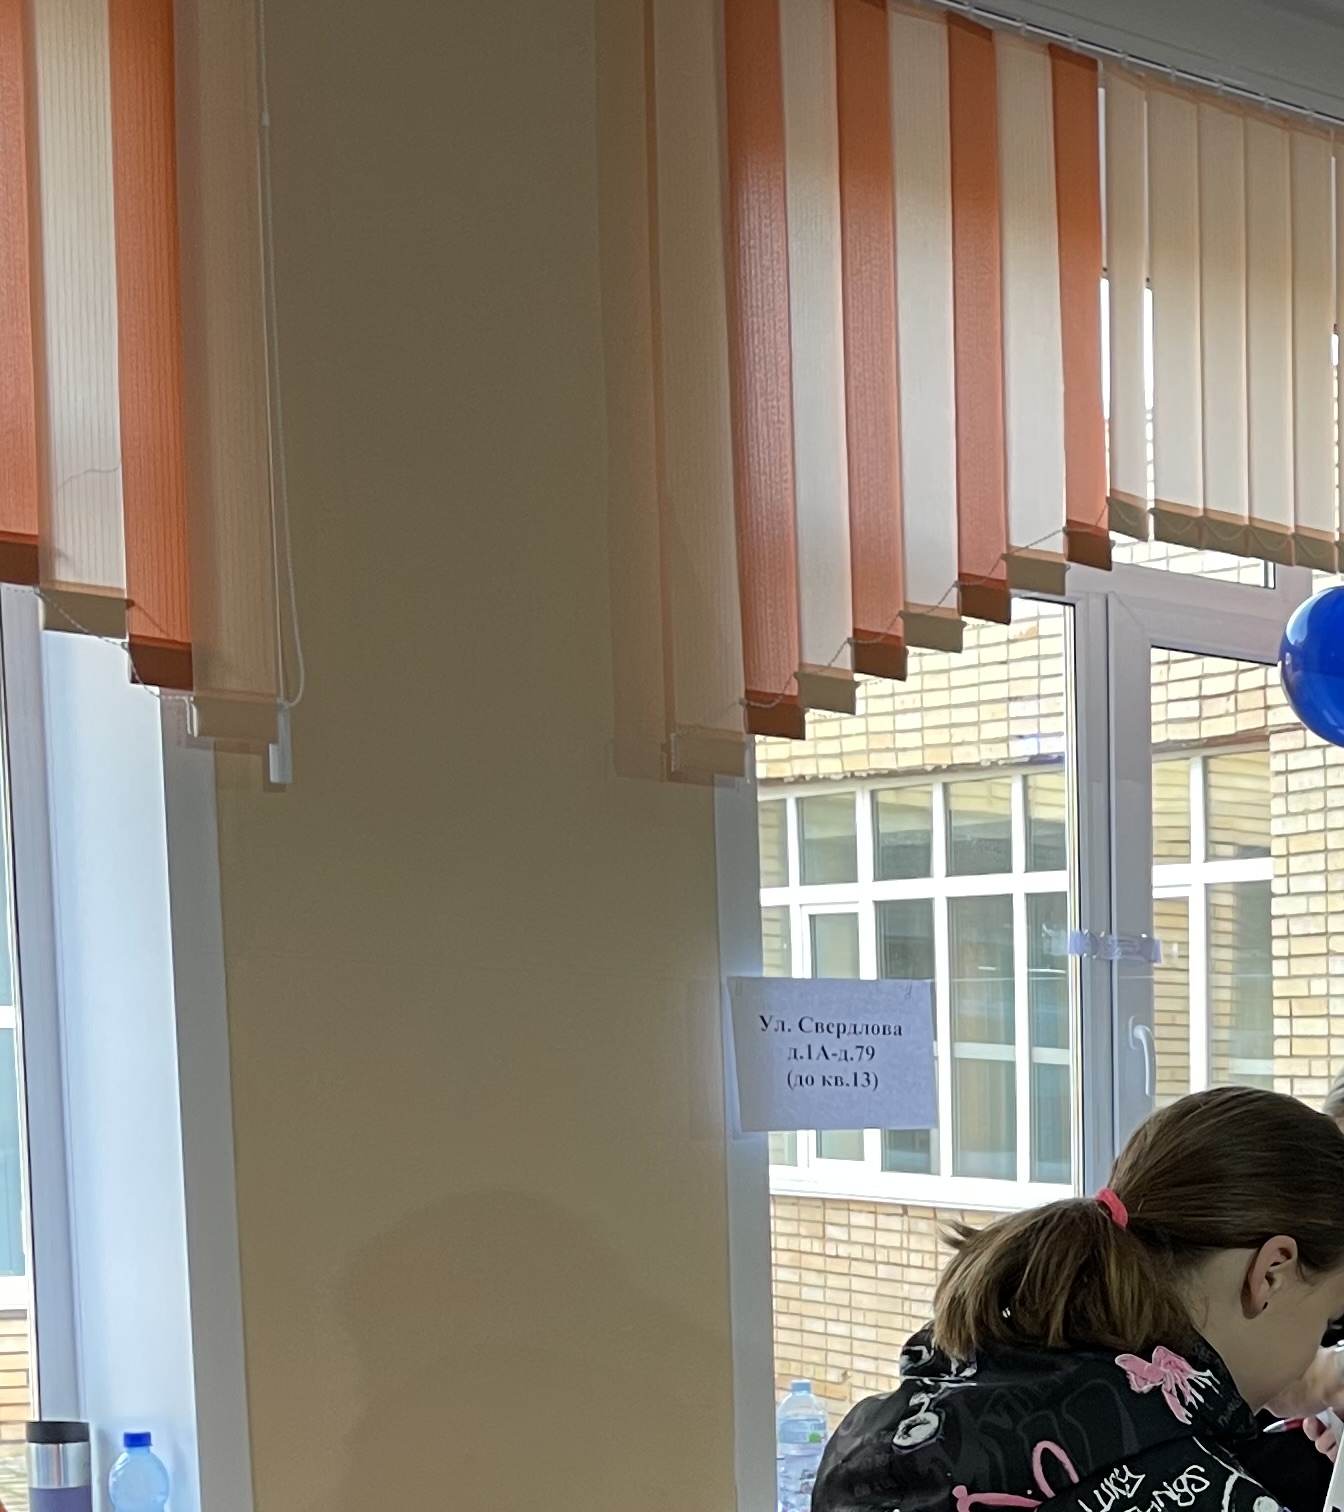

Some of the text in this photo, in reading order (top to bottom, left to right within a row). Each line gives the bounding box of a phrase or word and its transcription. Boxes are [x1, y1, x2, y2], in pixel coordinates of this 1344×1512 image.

[759, 1015, 903, 1038] Ул. Свердлова
[787, 1044, 876, 1063] д.1А-д.79
[786, 1071, 879, 1092] (до кв.13)
